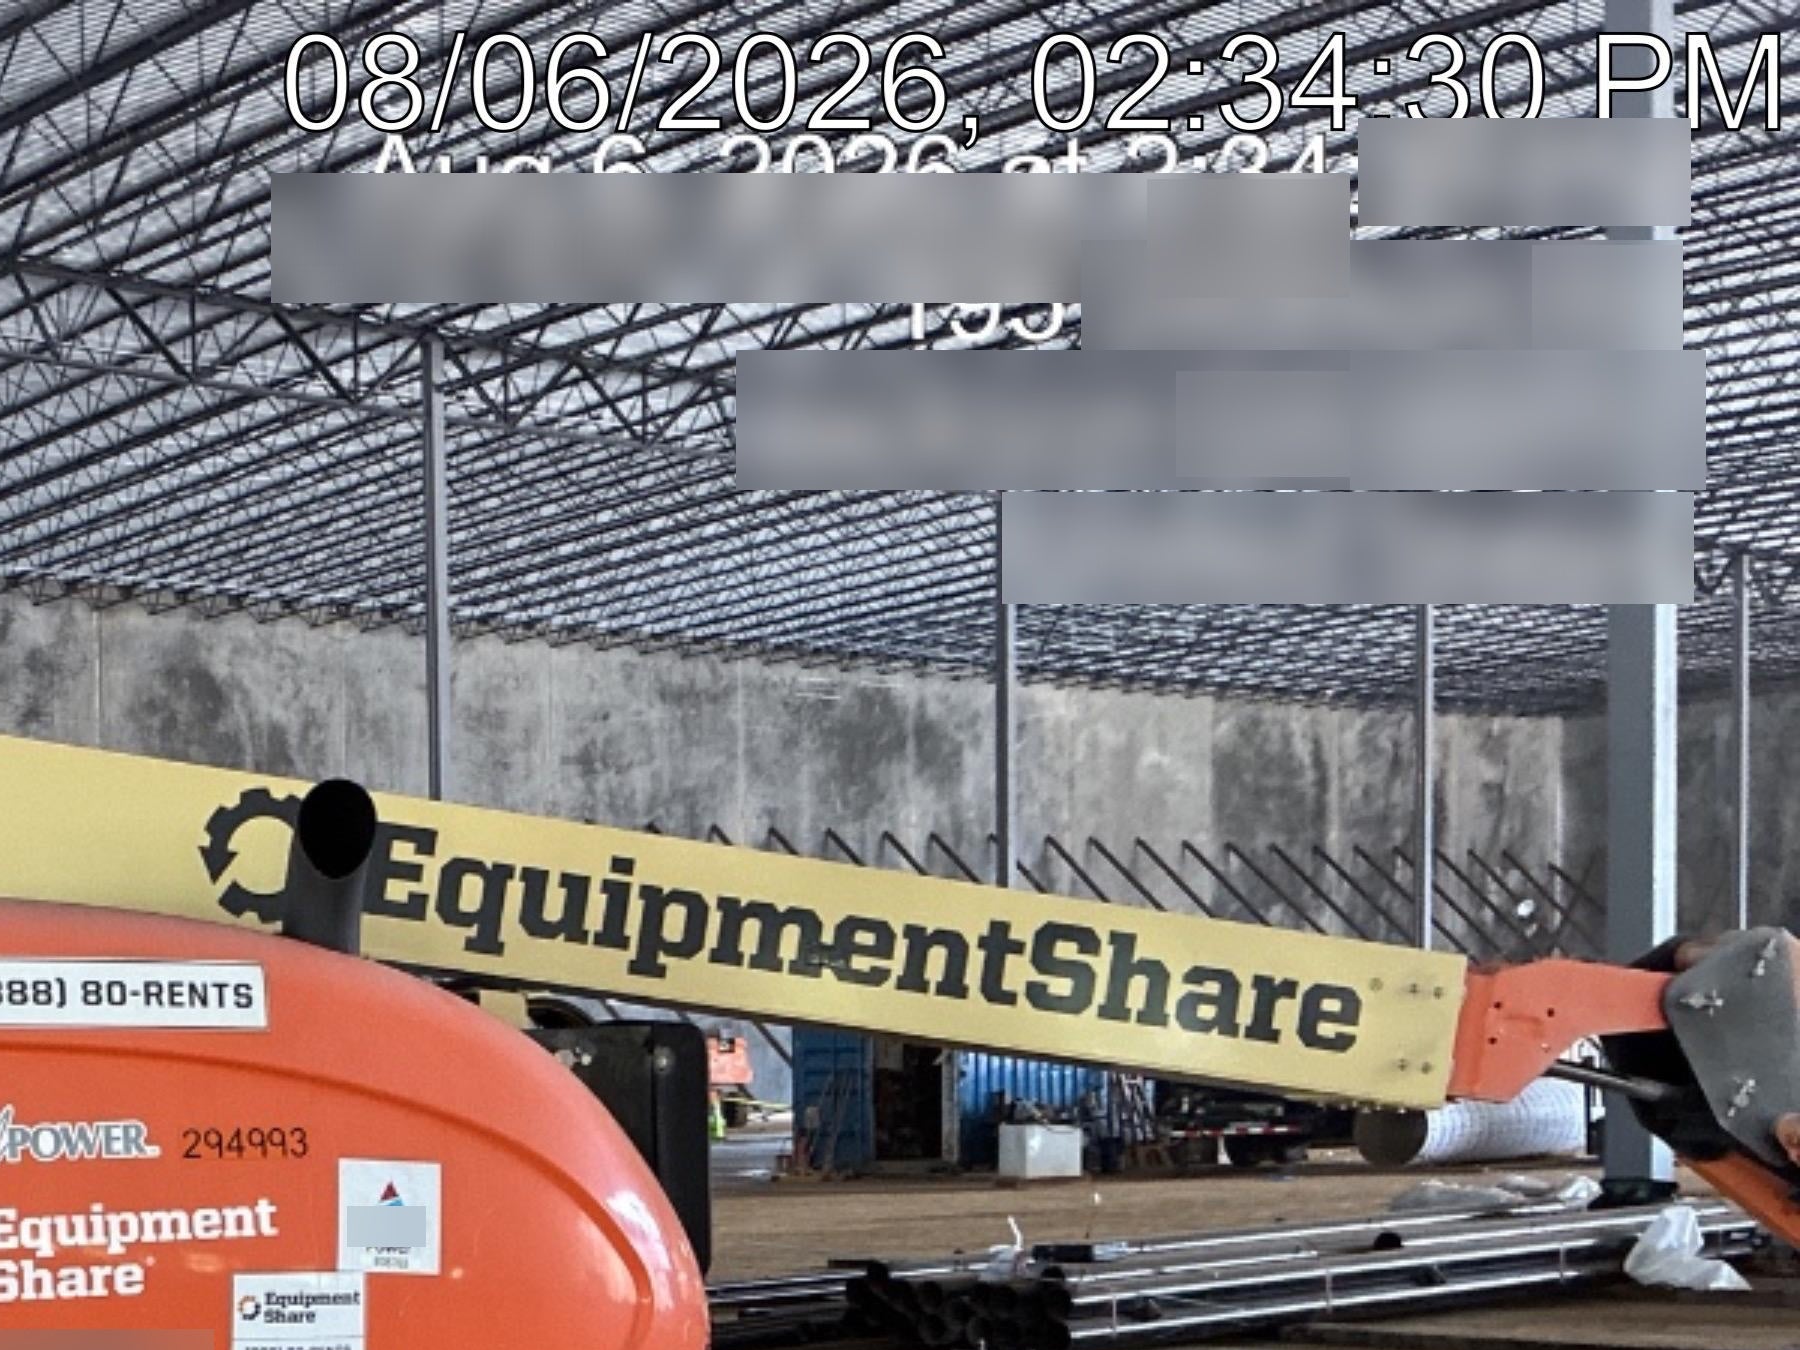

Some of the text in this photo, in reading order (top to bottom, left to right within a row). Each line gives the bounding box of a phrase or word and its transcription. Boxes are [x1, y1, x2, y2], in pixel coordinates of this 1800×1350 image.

[80, 979, 254, 1010] 80-RENTS
[182, 1127, 310, 1160] 294993
[263, 1289, 361, 1309] Equipment
[263, 1308, 317, 1324] Share
